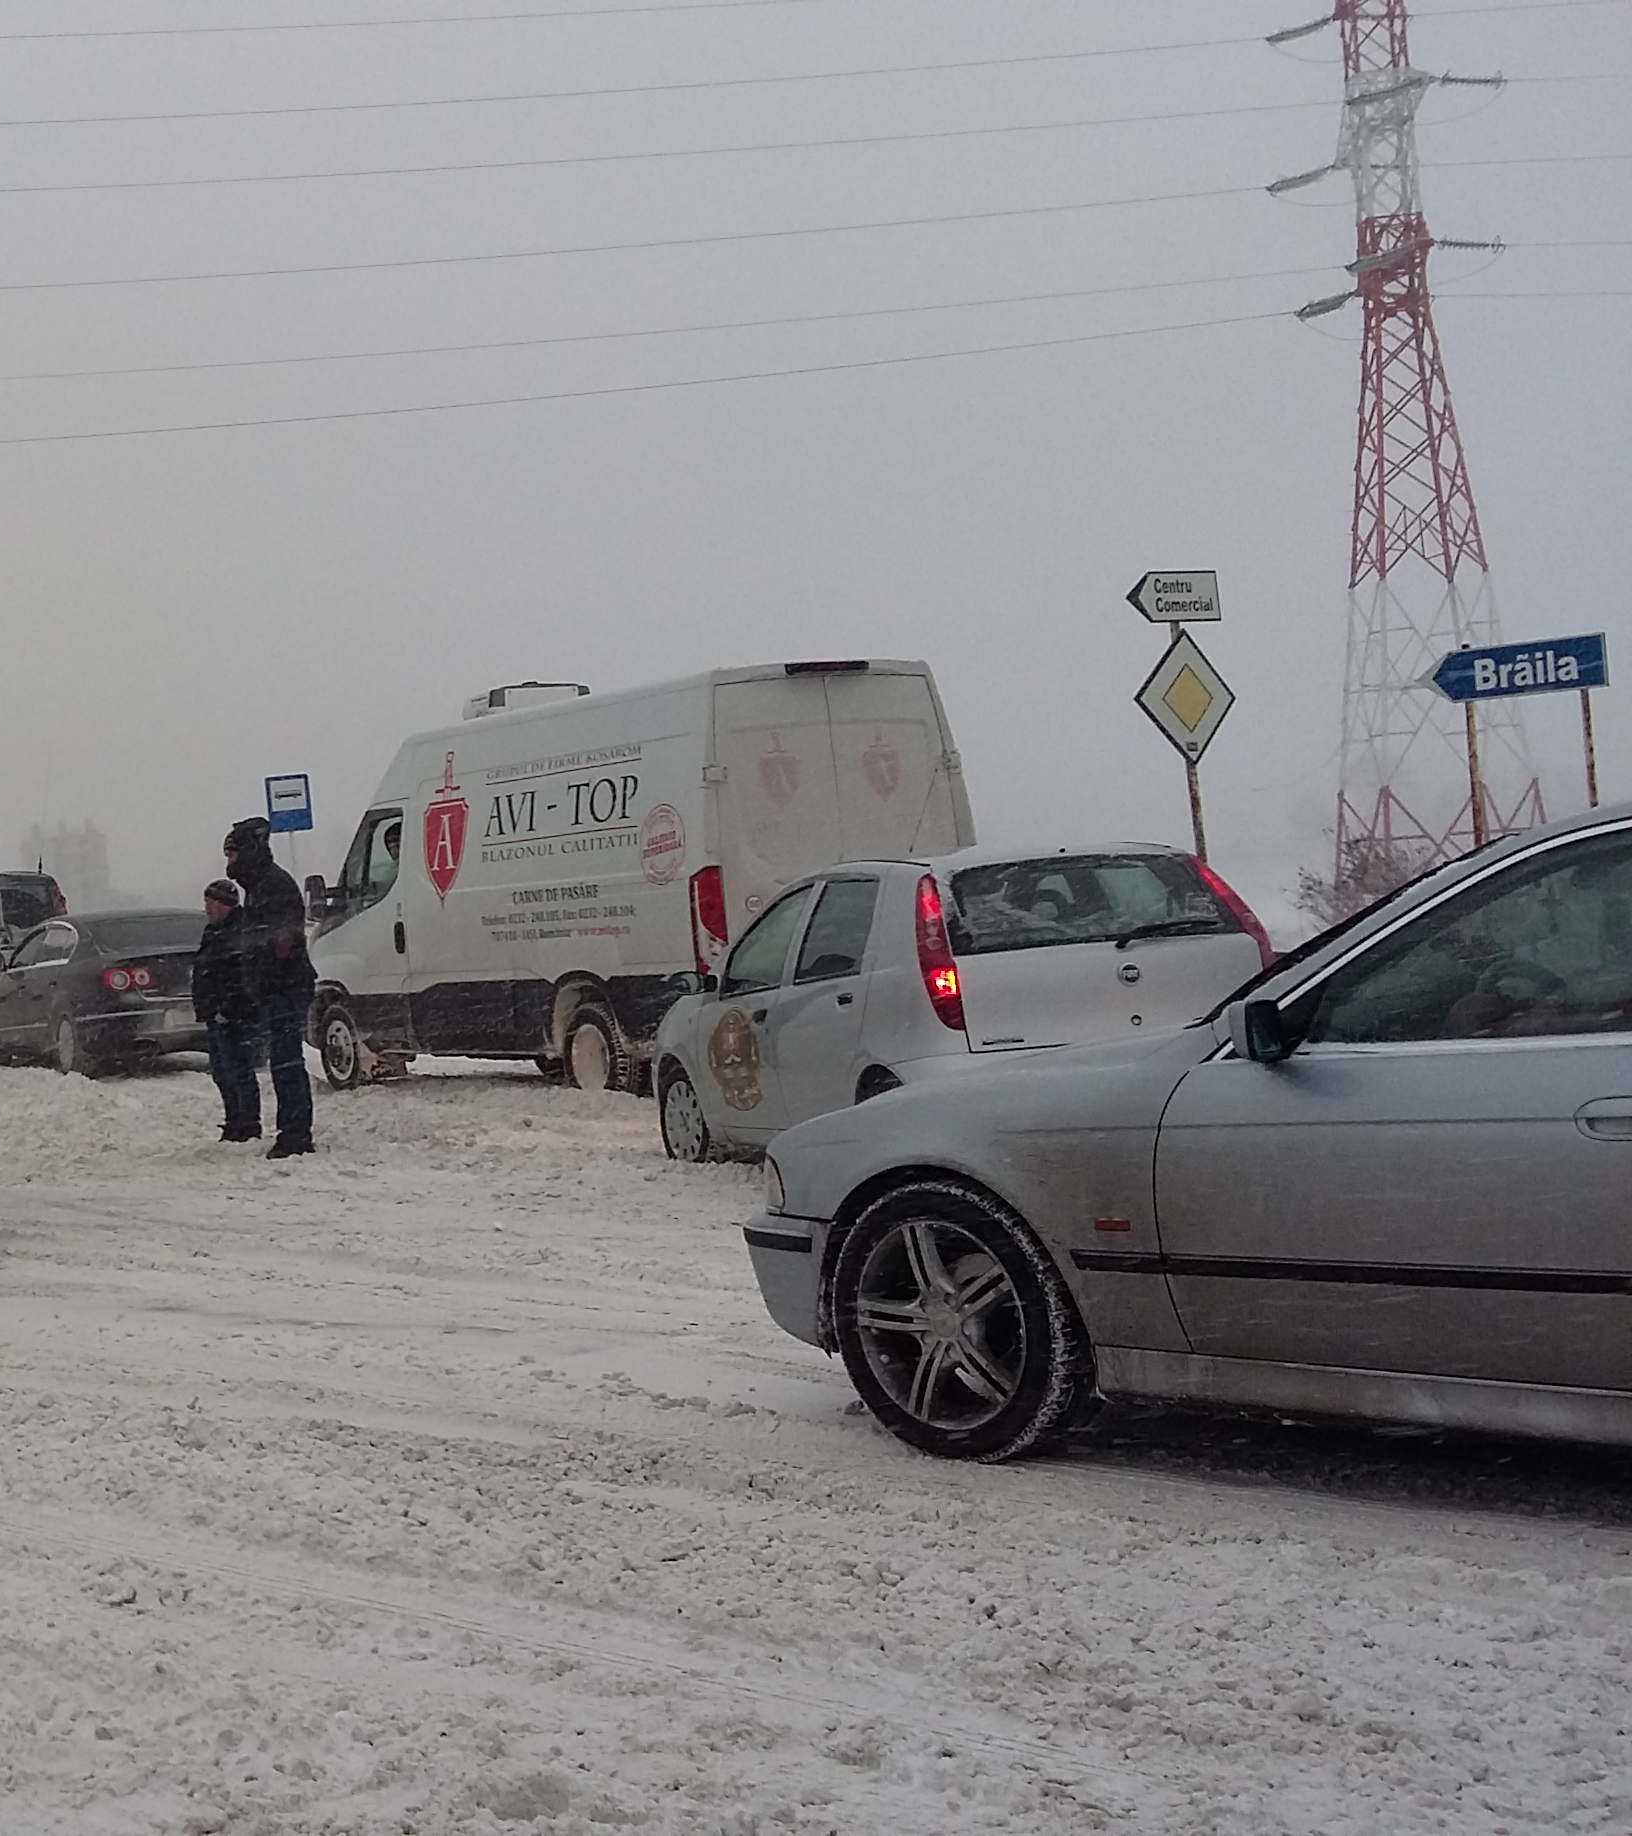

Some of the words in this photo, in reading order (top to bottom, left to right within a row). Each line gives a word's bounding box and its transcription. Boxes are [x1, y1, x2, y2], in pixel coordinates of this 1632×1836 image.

[1154, 578, 1192, 593] Centru
[1156, 596, 1213, 612] Comercial
[484, 791, 537, 837] AVI
[567, 775, 638, 825] TOP
[431, 813, 456, 871] A
[482, 844, 554, 862] BLAZONUL
[513, 889, 543, 905] CARNE
[545, 887, 558, 902] DE
